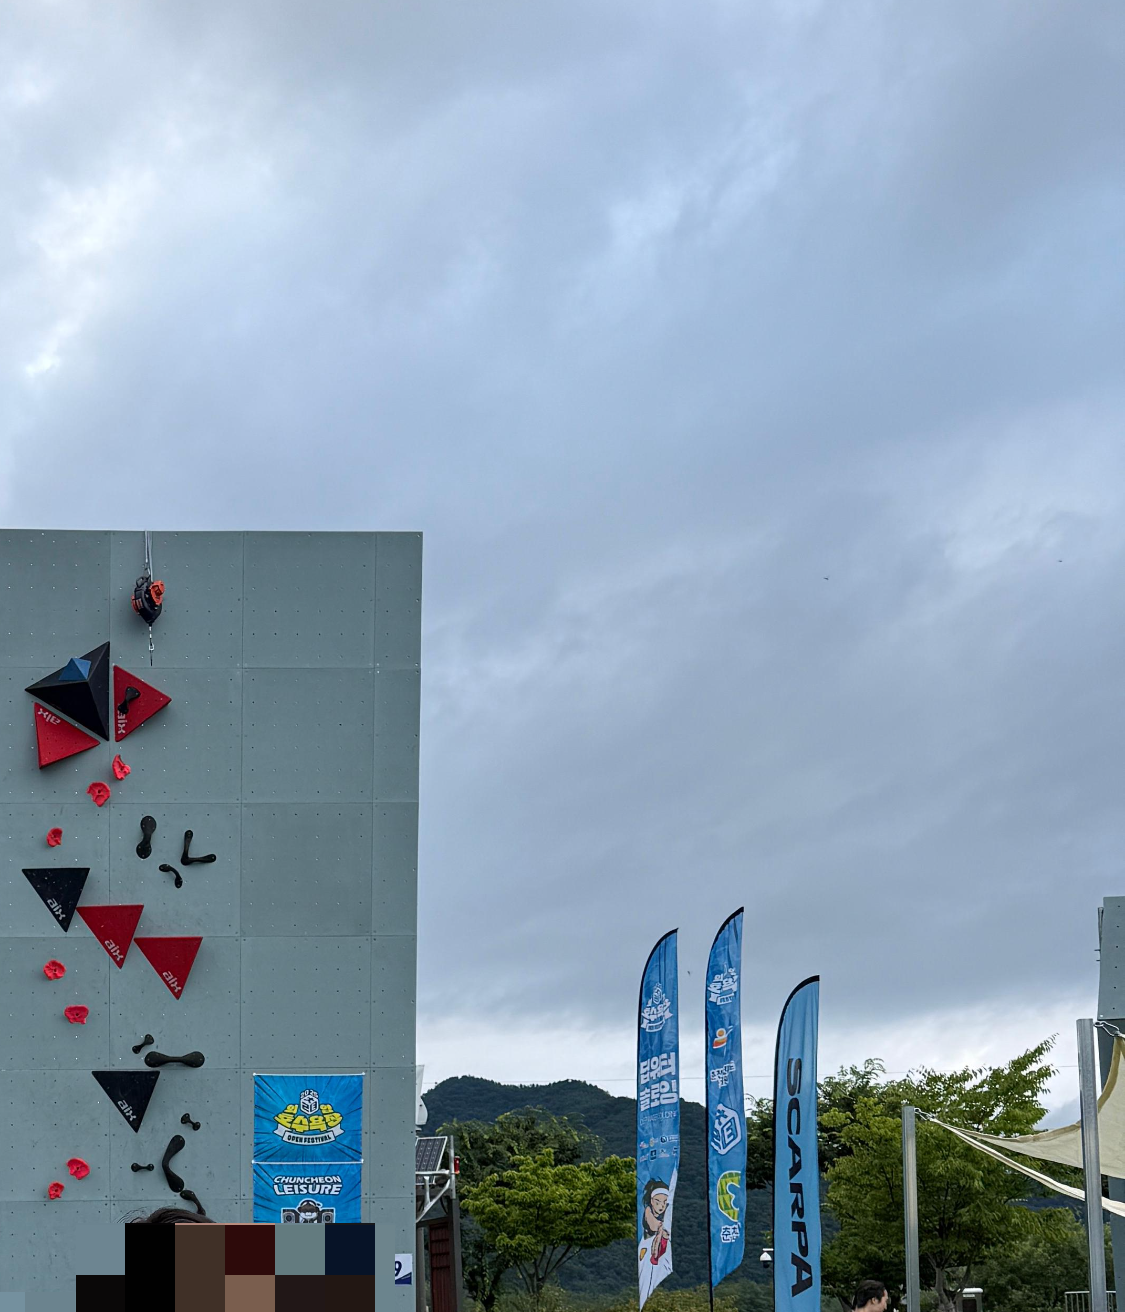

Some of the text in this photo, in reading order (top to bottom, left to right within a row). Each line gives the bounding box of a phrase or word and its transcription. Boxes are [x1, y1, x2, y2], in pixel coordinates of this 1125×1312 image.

[274, 1175, 342, 1184] CHUNCHEON
[787, 1057, 813, 1298] SCARPA
[273, 1184, 343, 1195] LEISURE
[394, 1260, 403, 1277] 9
